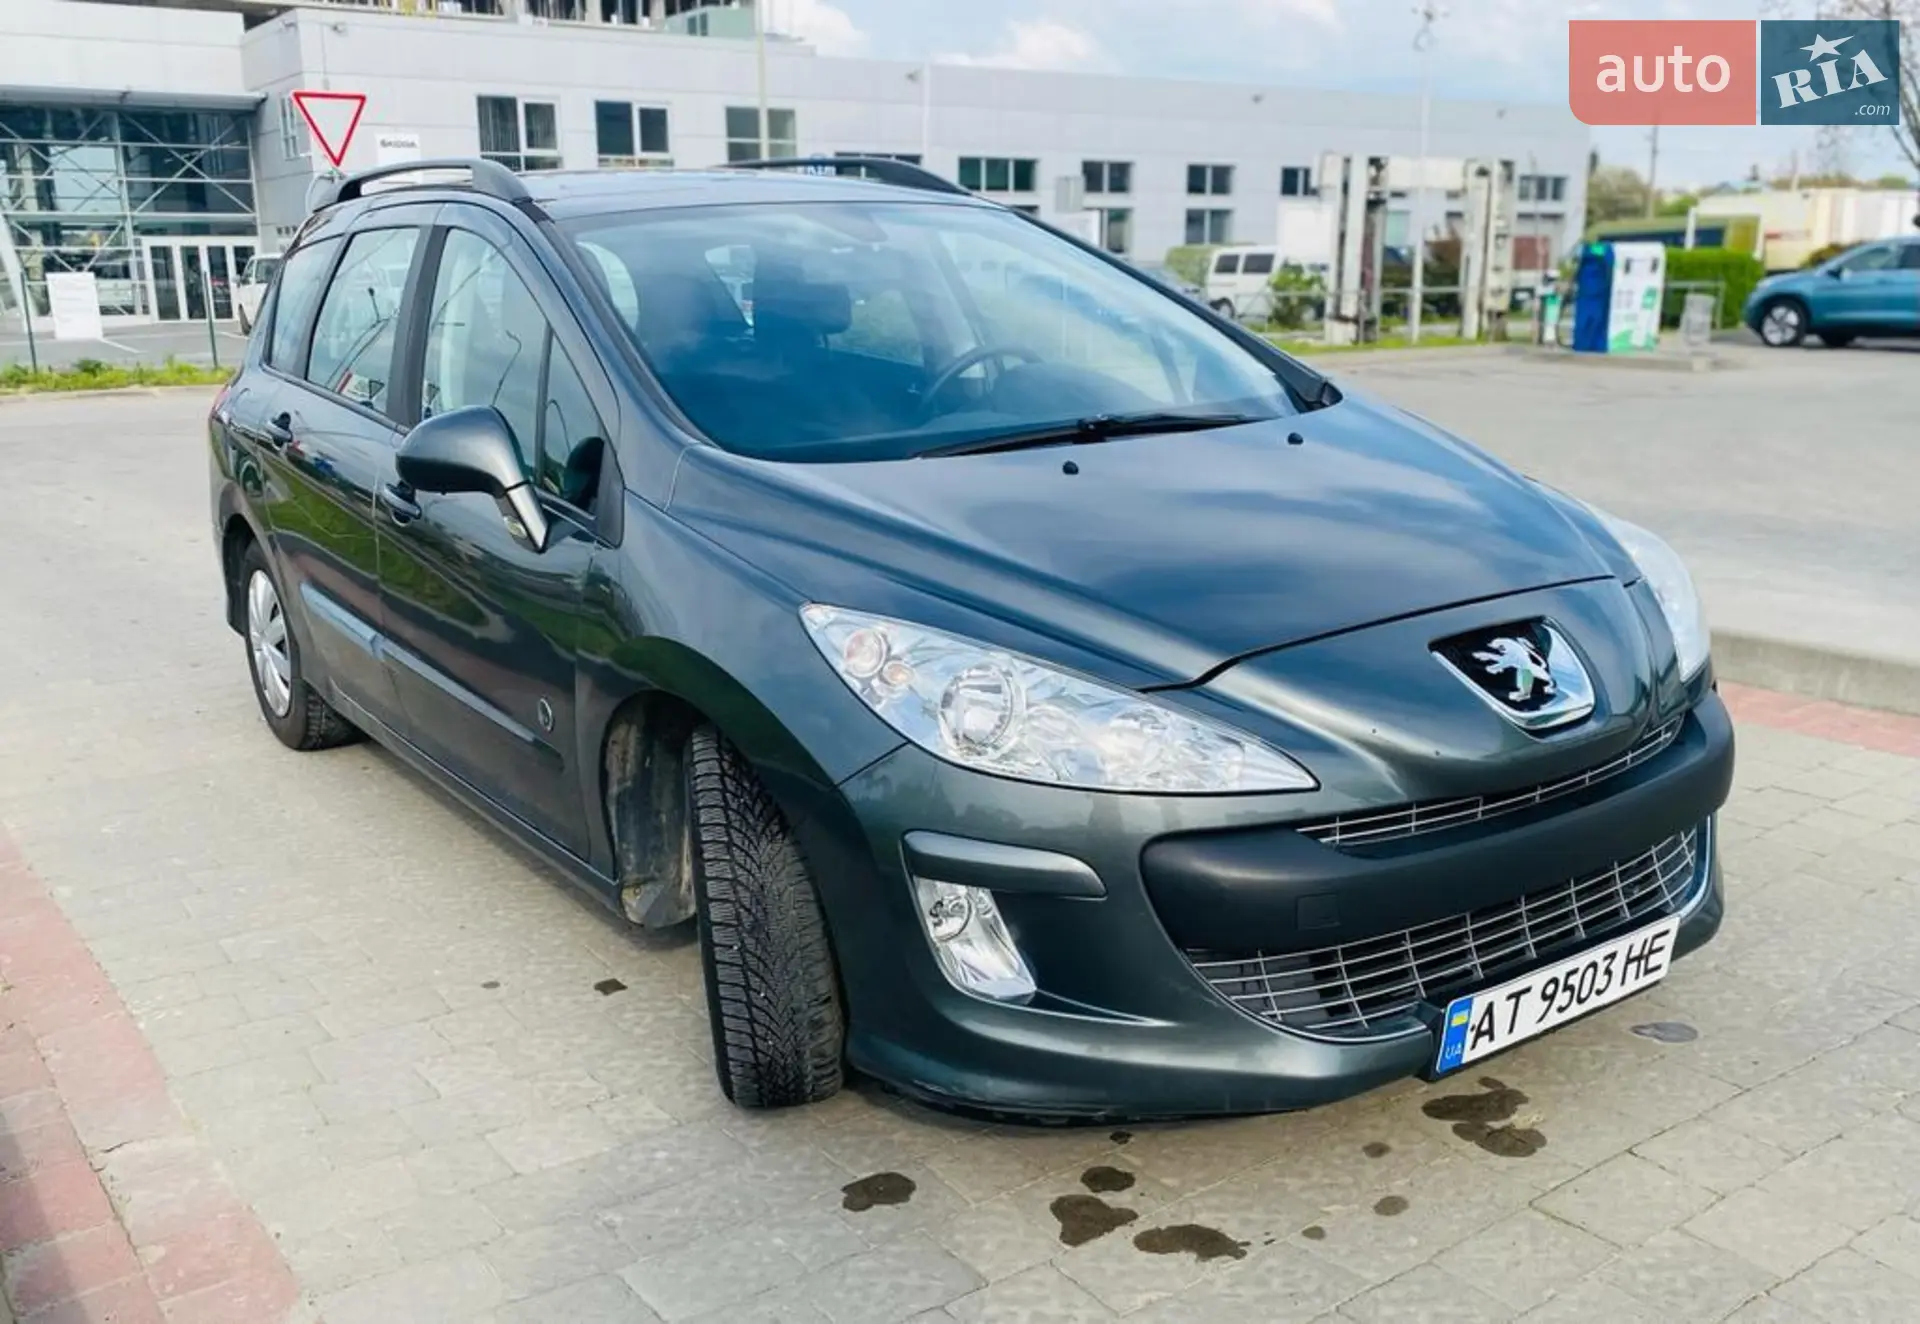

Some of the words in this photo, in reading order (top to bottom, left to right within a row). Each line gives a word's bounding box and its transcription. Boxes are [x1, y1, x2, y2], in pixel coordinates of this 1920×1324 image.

[1469, 986, 1533, 1051] AT
[1536, 950, 1618, 1024] 9503
[1620, 928, 1671, 986] HE
[1445, 1042, 1462, 1059] UA
